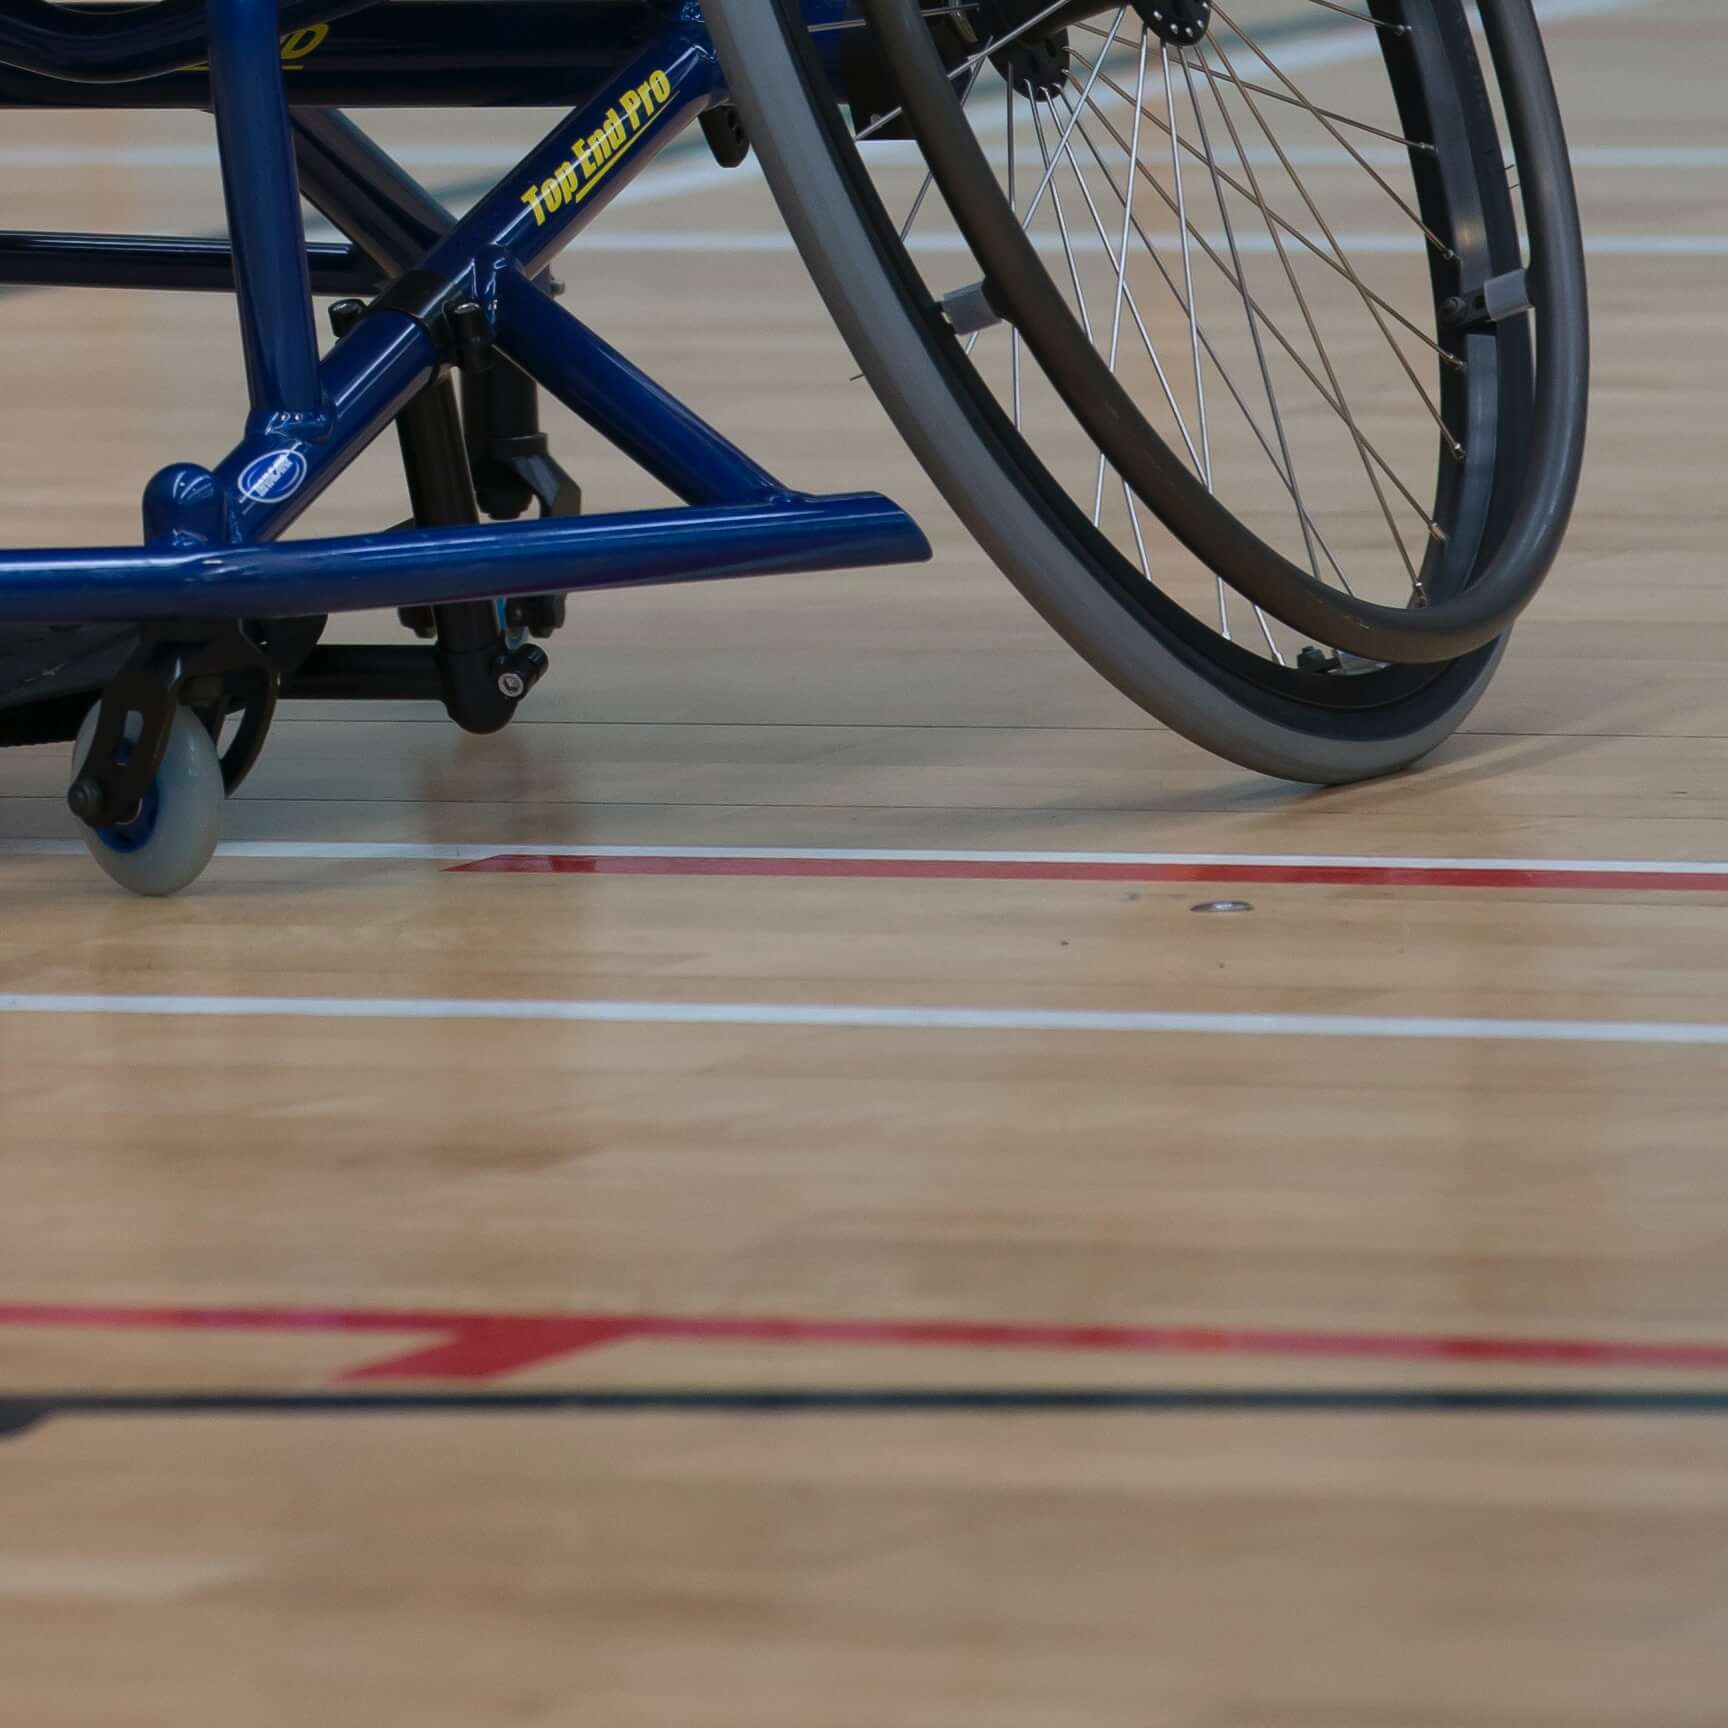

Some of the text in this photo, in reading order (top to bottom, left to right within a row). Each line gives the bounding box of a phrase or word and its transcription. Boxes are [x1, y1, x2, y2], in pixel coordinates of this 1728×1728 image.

[520, 68, 672, 227] Top End Pro
